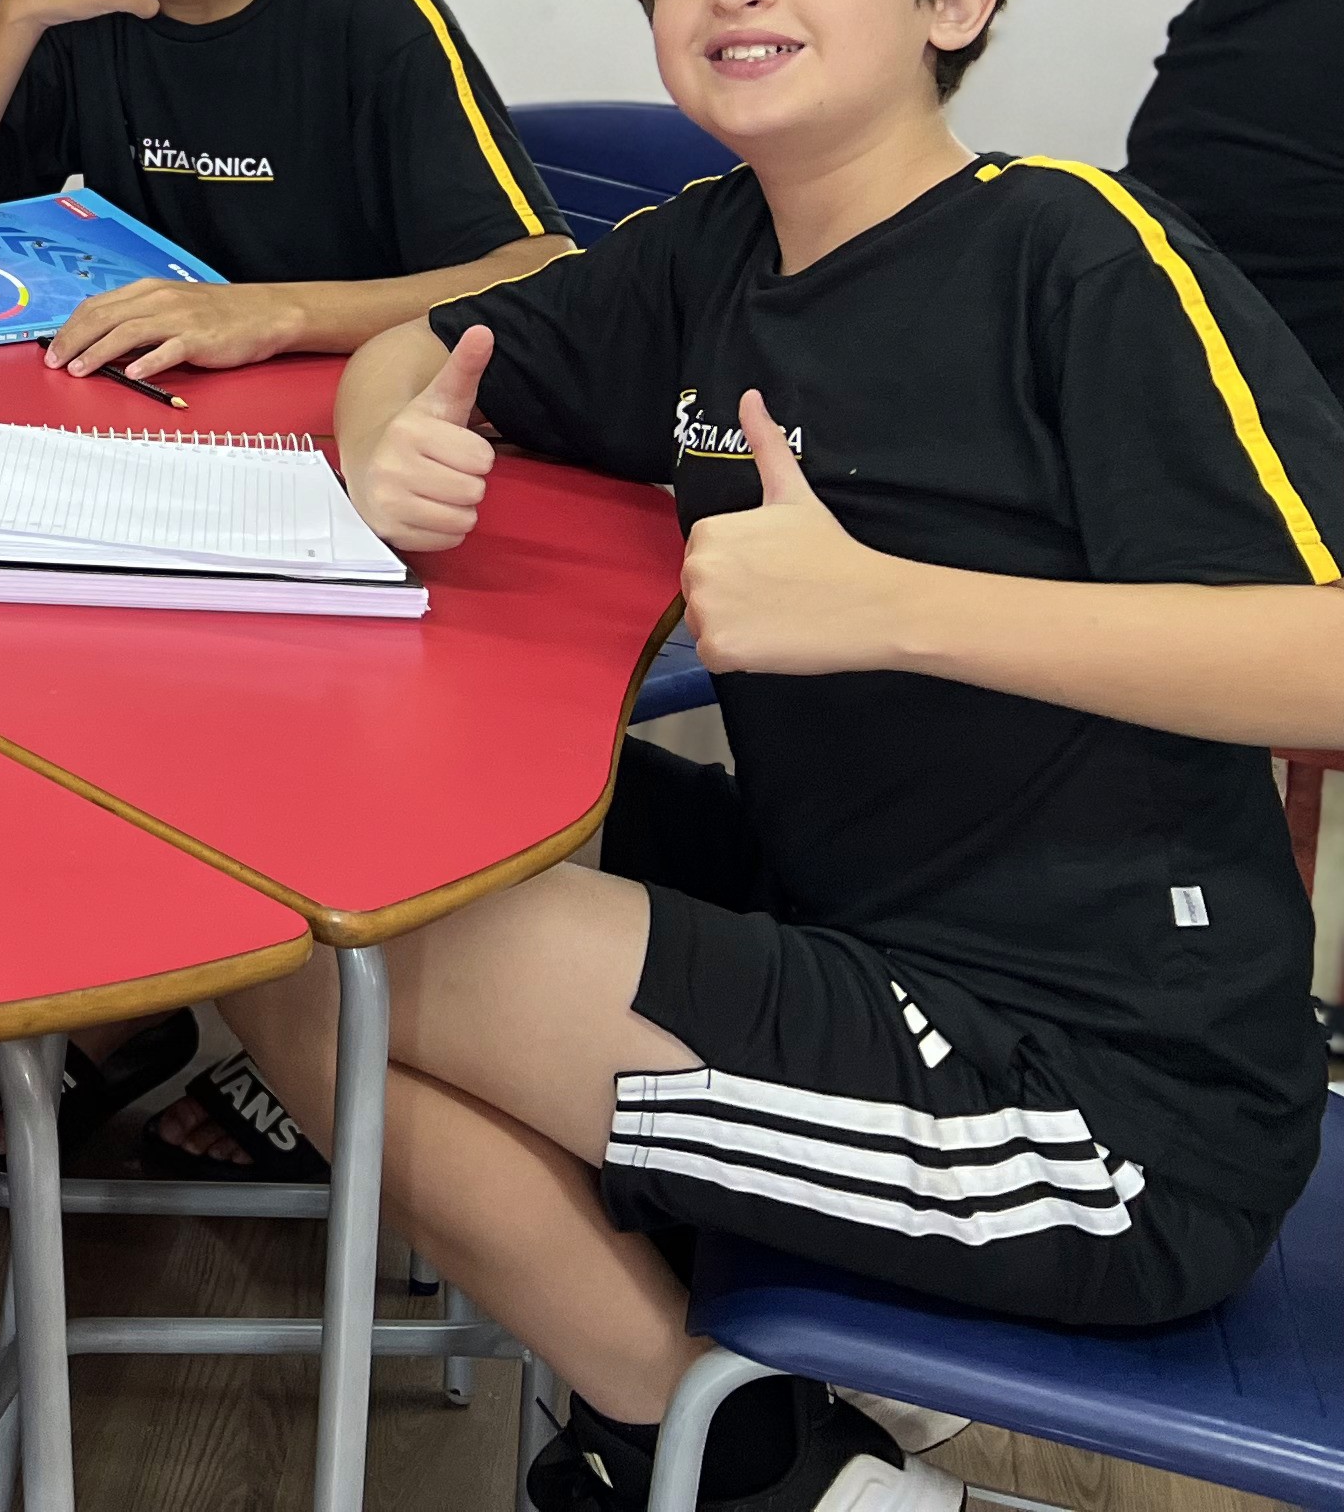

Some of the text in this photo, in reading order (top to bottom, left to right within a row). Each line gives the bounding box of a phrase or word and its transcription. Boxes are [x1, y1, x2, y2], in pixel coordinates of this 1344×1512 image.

[141, 148, 273, 176] NTA ÔNICA
[210, 1055, 302, 1151] VANS
